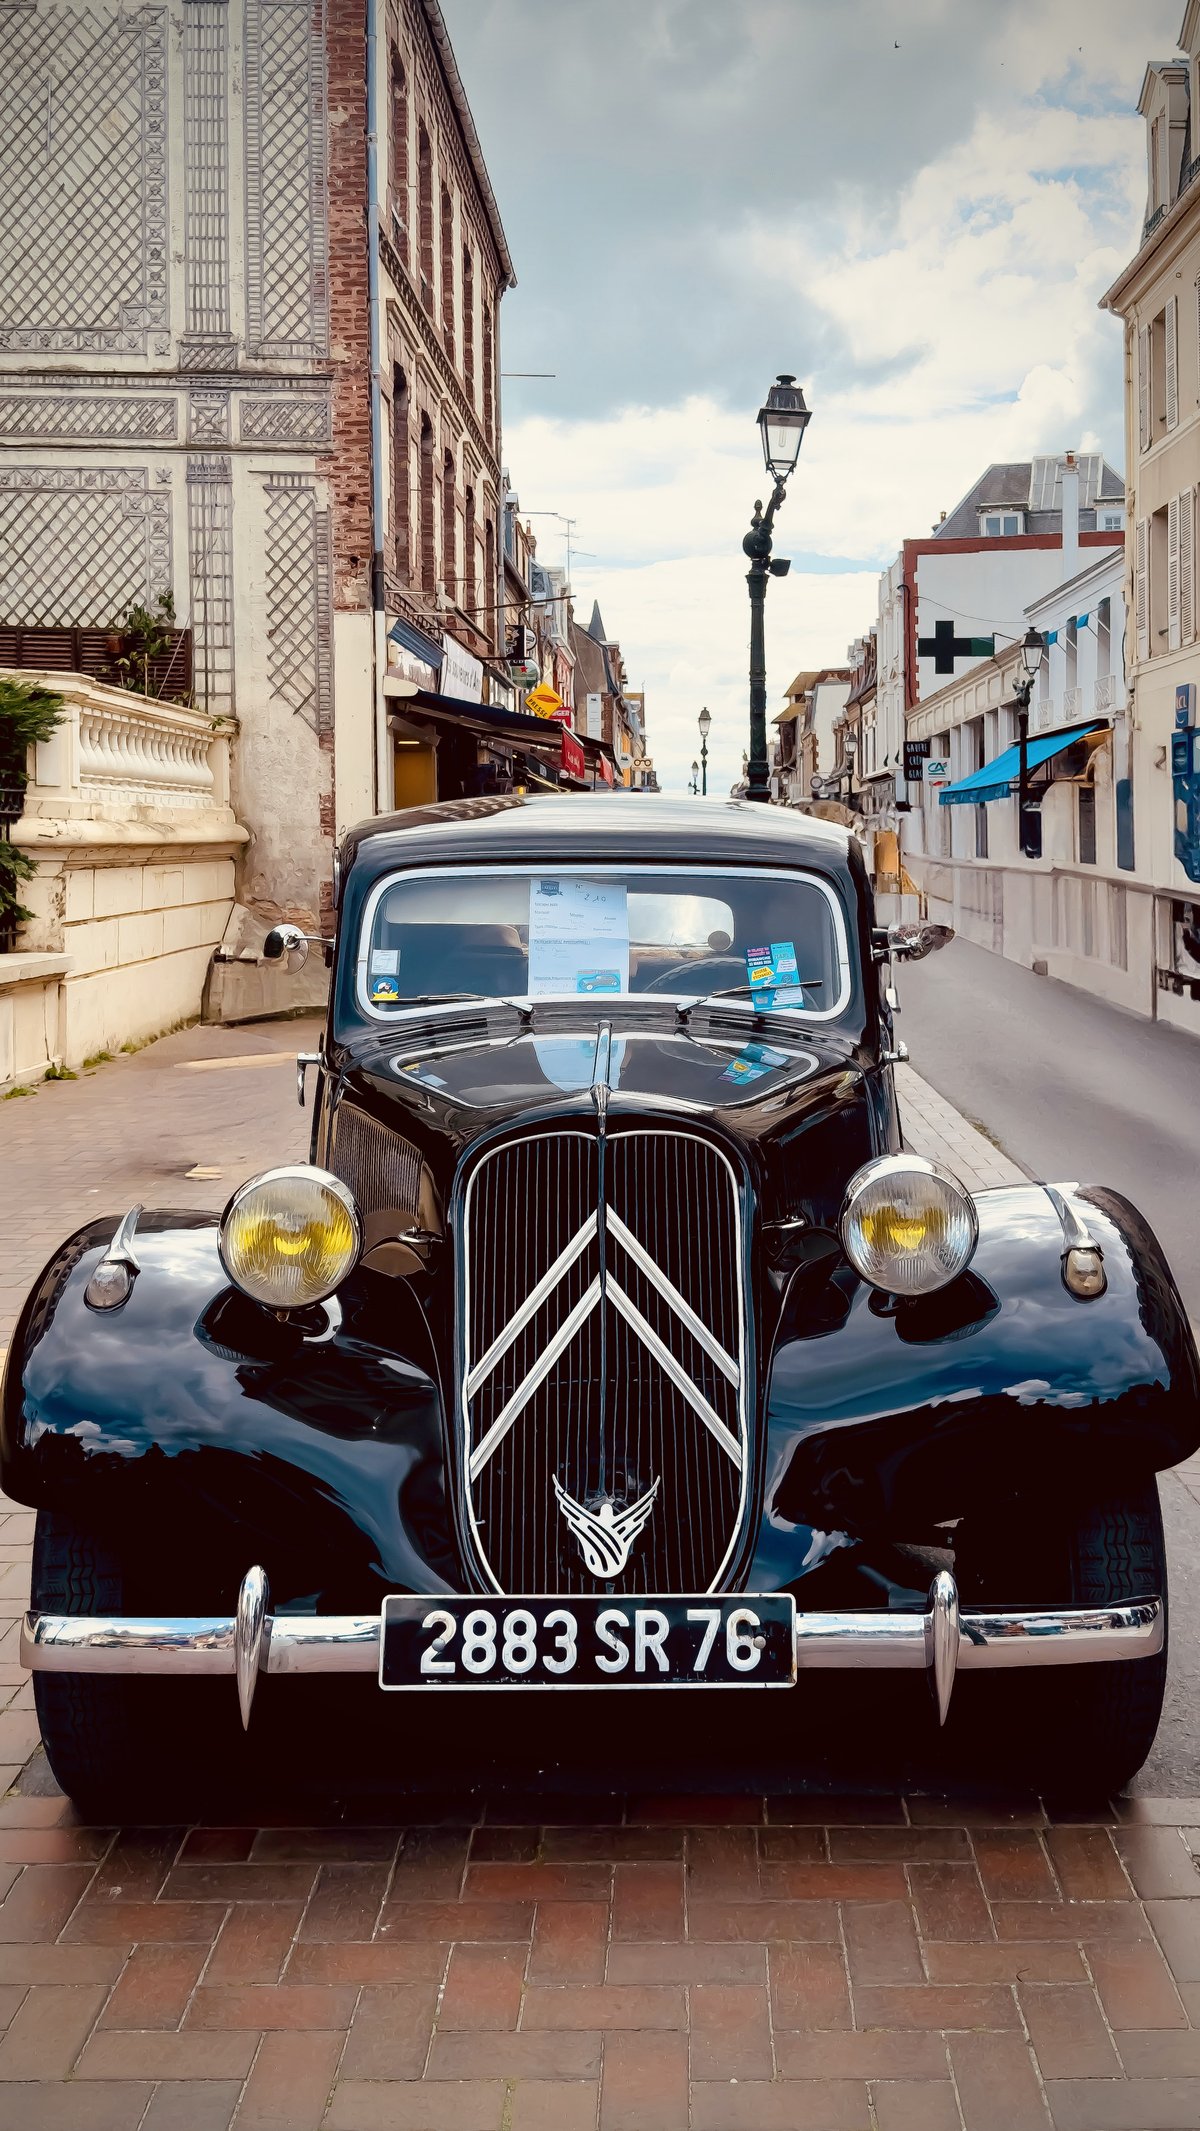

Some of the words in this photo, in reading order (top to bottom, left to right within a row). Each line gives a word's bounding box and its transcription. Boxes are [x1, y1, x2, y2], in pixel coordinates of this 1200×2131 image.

[528, 698, 548, 718] PRESSE
[420, 1609, 578, 1675] 2883
[594, 1609, 670, 1674] SR
[686, 1608, 762, 1672] 76
